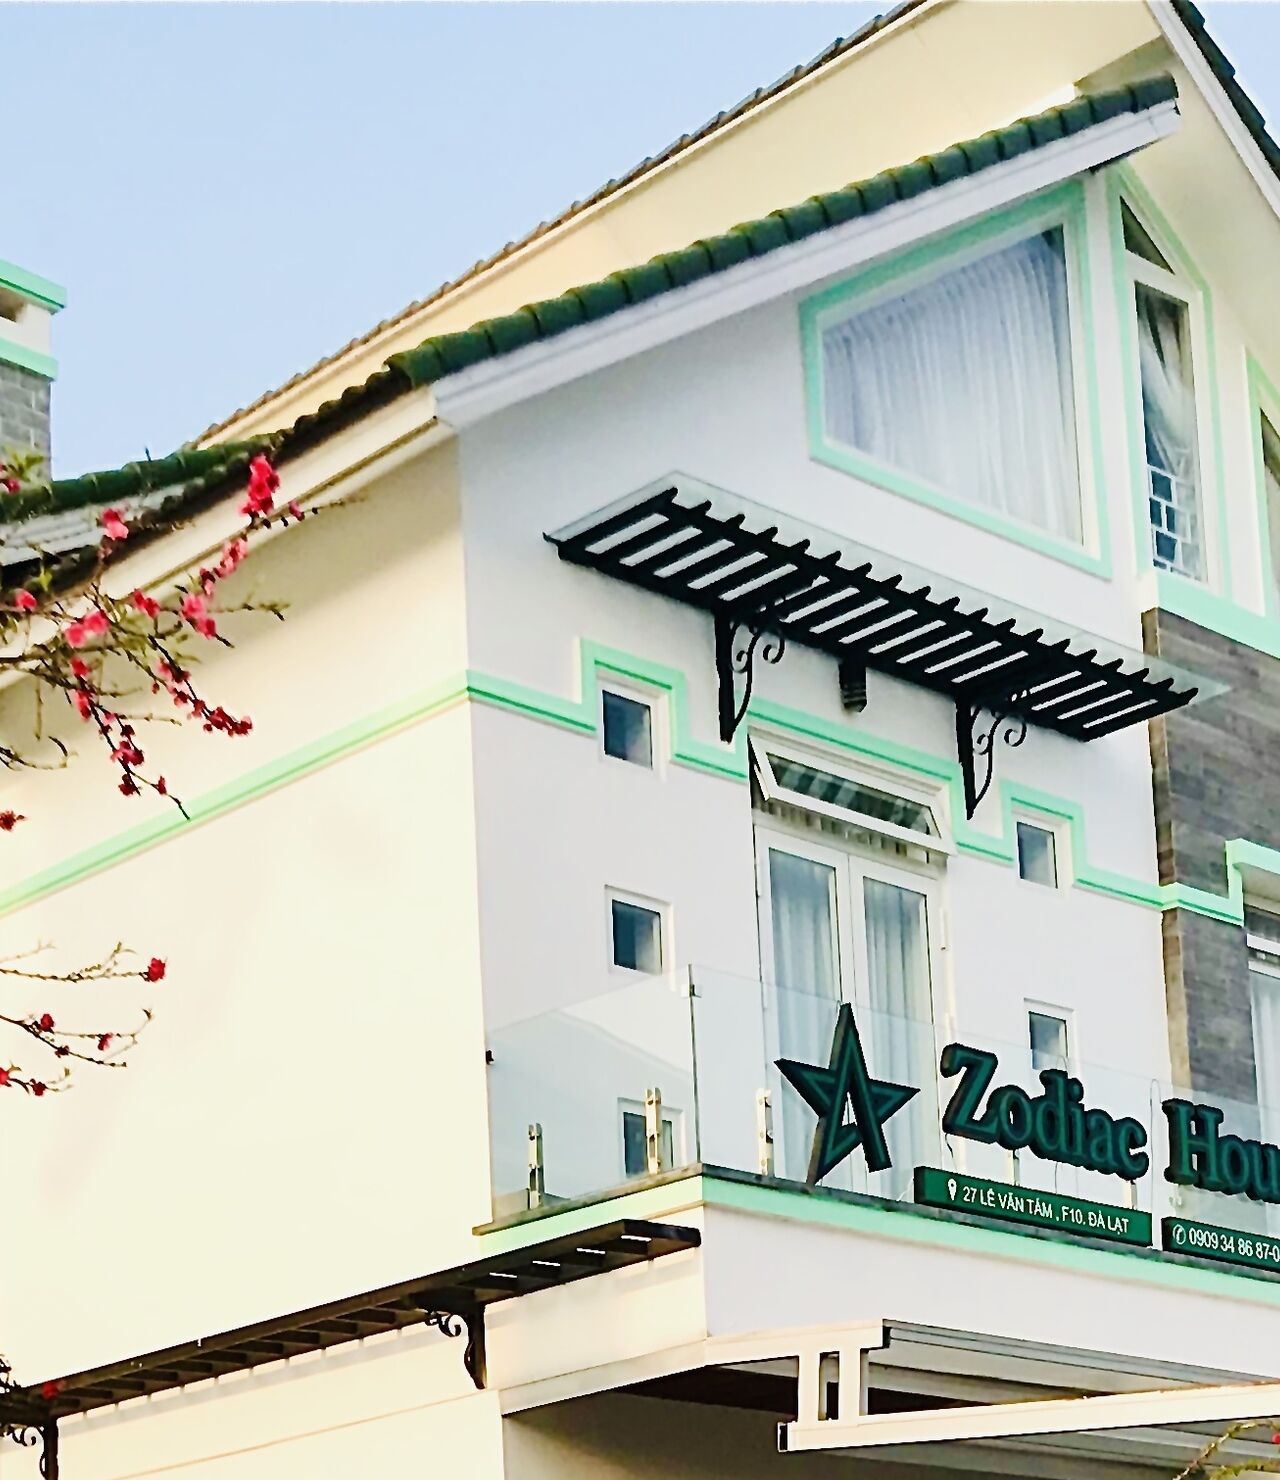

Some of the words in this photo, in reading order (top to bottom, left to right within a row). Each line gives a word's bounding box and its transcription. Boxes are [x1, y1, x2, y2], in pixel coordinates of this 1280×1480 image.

[940, 1042, 1149, 1180] Zodiac
[962, 1186, 978, 1203] 27
[979, 1187, 996, 1208] LÊ
[1188, 1227, 1219, 1250] 0909
[1221, 1234, 1235, 1254] 34
[1237, 1237, 1254, 1257] 86
